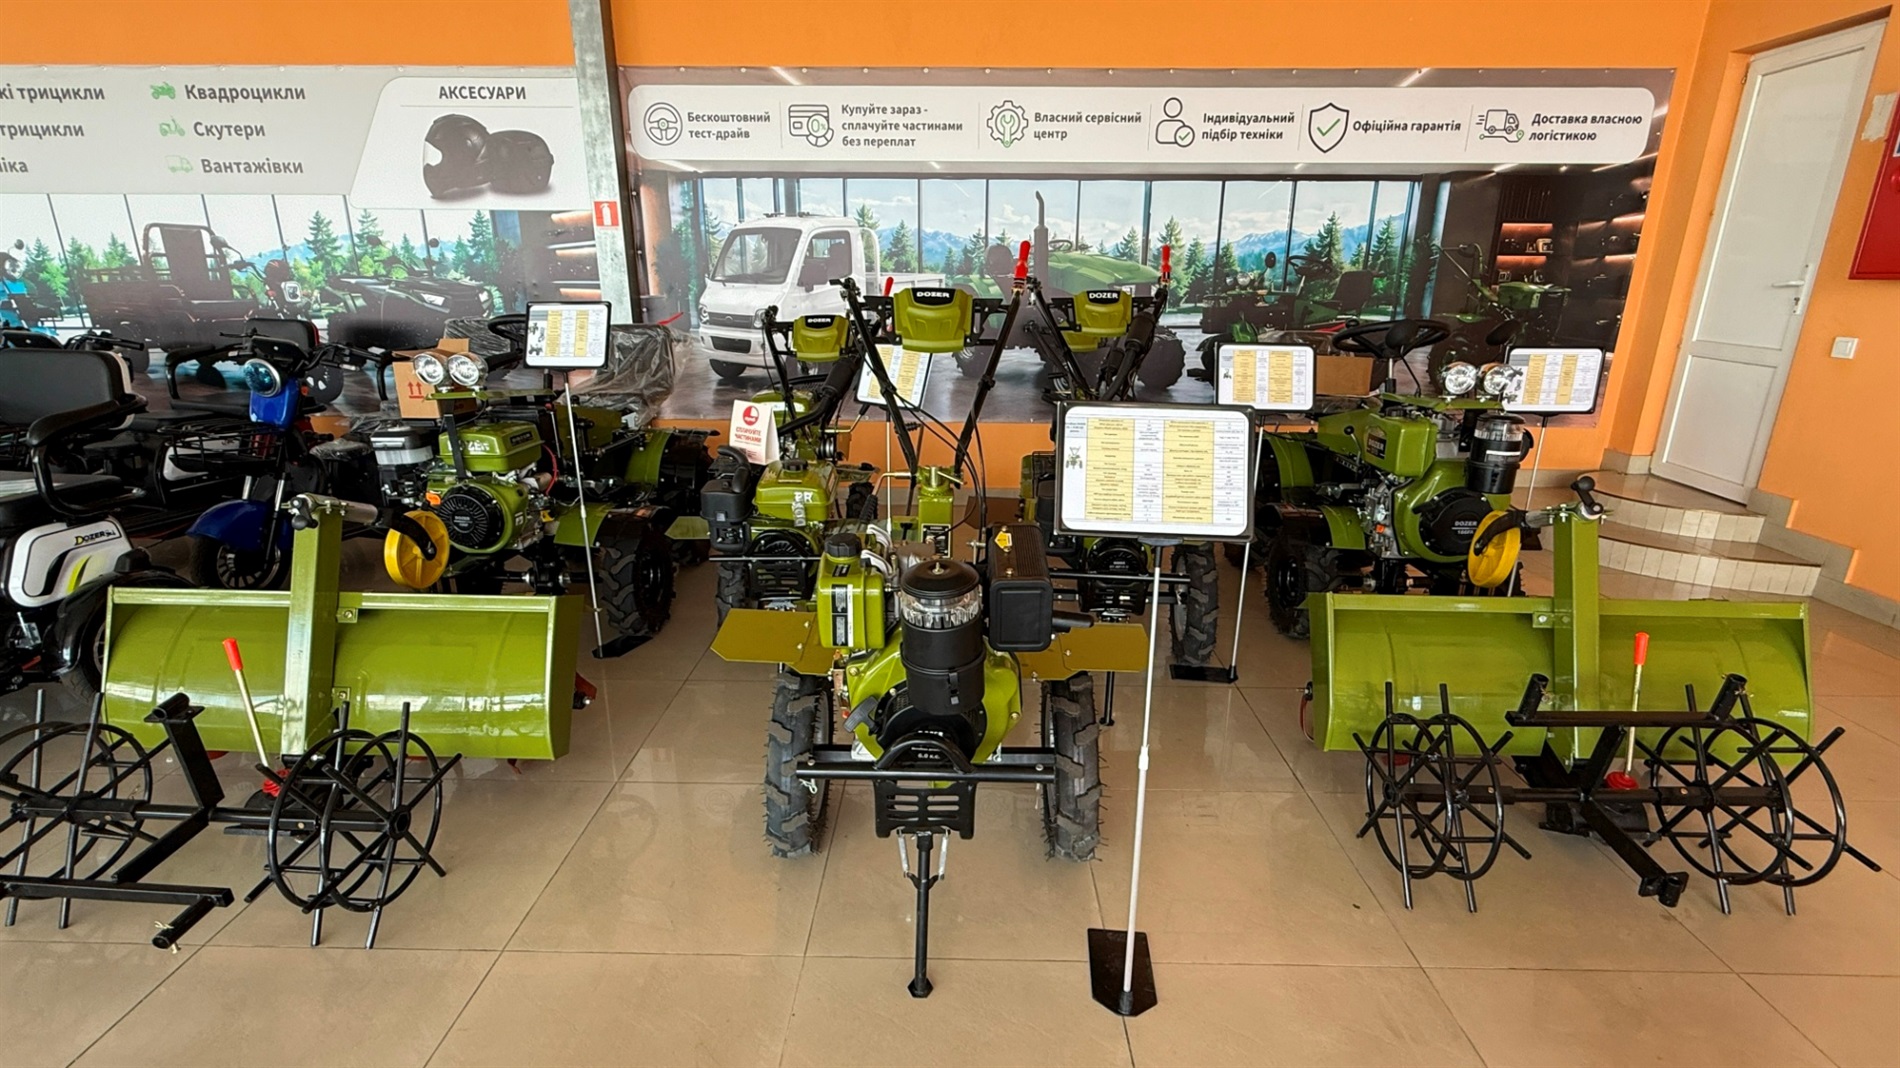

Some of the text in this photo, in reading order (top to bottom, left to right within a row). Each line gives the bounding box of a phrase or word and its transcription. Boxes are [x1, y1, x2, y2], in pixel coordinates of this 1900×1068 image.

[16, 87, 106, 104] трицикли
[184, 84, 306, 104] Квадроцикли
[438, 85, 527, 100] АКСЕСУАРИ
[687, 111, 771, 123] Бескоштовний
[841, 102, 888, 118] Купуйте
[890, 106, 922, 118] зараз
[1034, 111, 1142, 126] Власний сервісний
[1202, 111, 1296, 127] Індивідуальний
[1531, 112, 1643, 127] Доставка власною
[0, 124, 85, 141] трицикли
[193, 121, 266, 141] Скутери
[841, 119, 963, 134] сплачуйте частинами
[1352, 119, 1462, 135] Офіційна гарантія
[688, 127, 751, 142] тест-драйв
[841, 135, 917, 149] без переплат
[1033, 130, 1068, 142] центр
[1201, 128, 1284, 143] підбір техніки
[1528, 129, 1598, 142] логістикою
[200, 157, 304, 174] Вантажівки
[915, 290, 951, 300] DOZER
[1088, 290, 1119, 300] DOZER
[75, 530, 106, 546] DOZER
